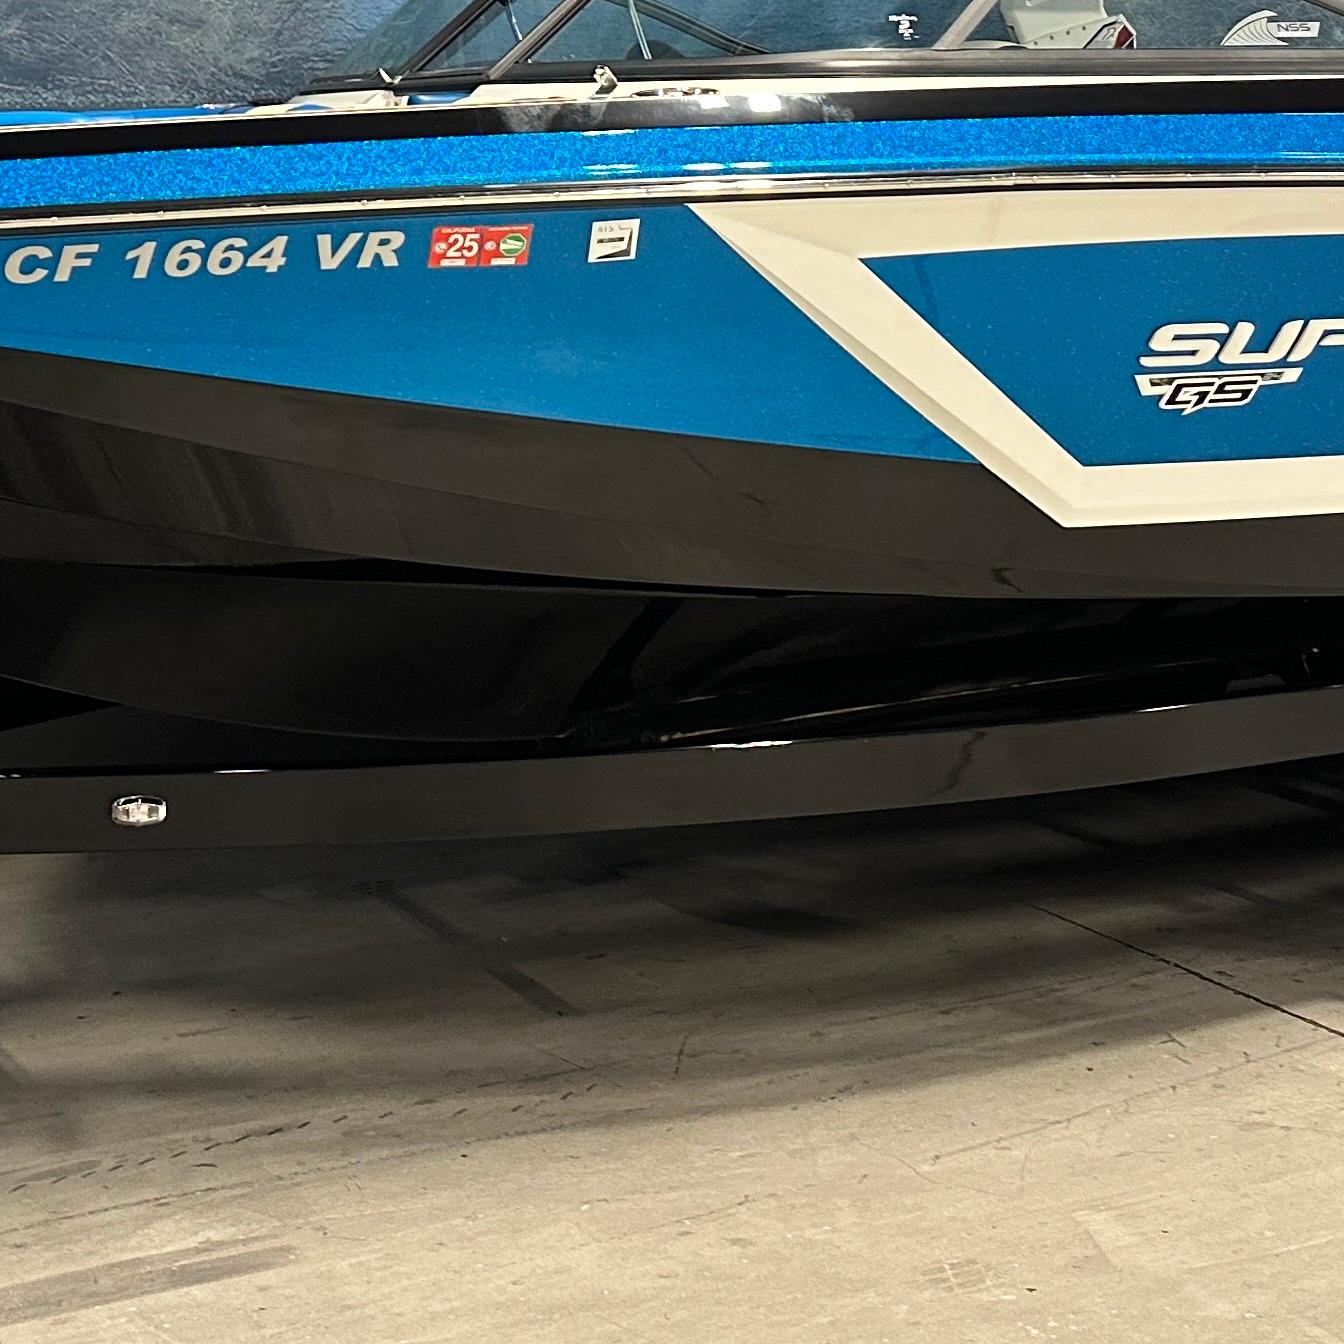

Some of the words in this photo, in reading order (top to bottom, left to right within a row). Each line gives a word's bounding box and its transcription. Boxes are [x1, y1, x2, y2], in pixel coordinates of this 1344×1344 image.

[1276, 23, 1311, 33] NSS
[3, 243, 99, 284] CF
[124, 235, 289, 279] 1664
[316, 230, 406, 270] VR
[445, 233, 481, 258] 25
[1160, 376, 1261, 414] GS
